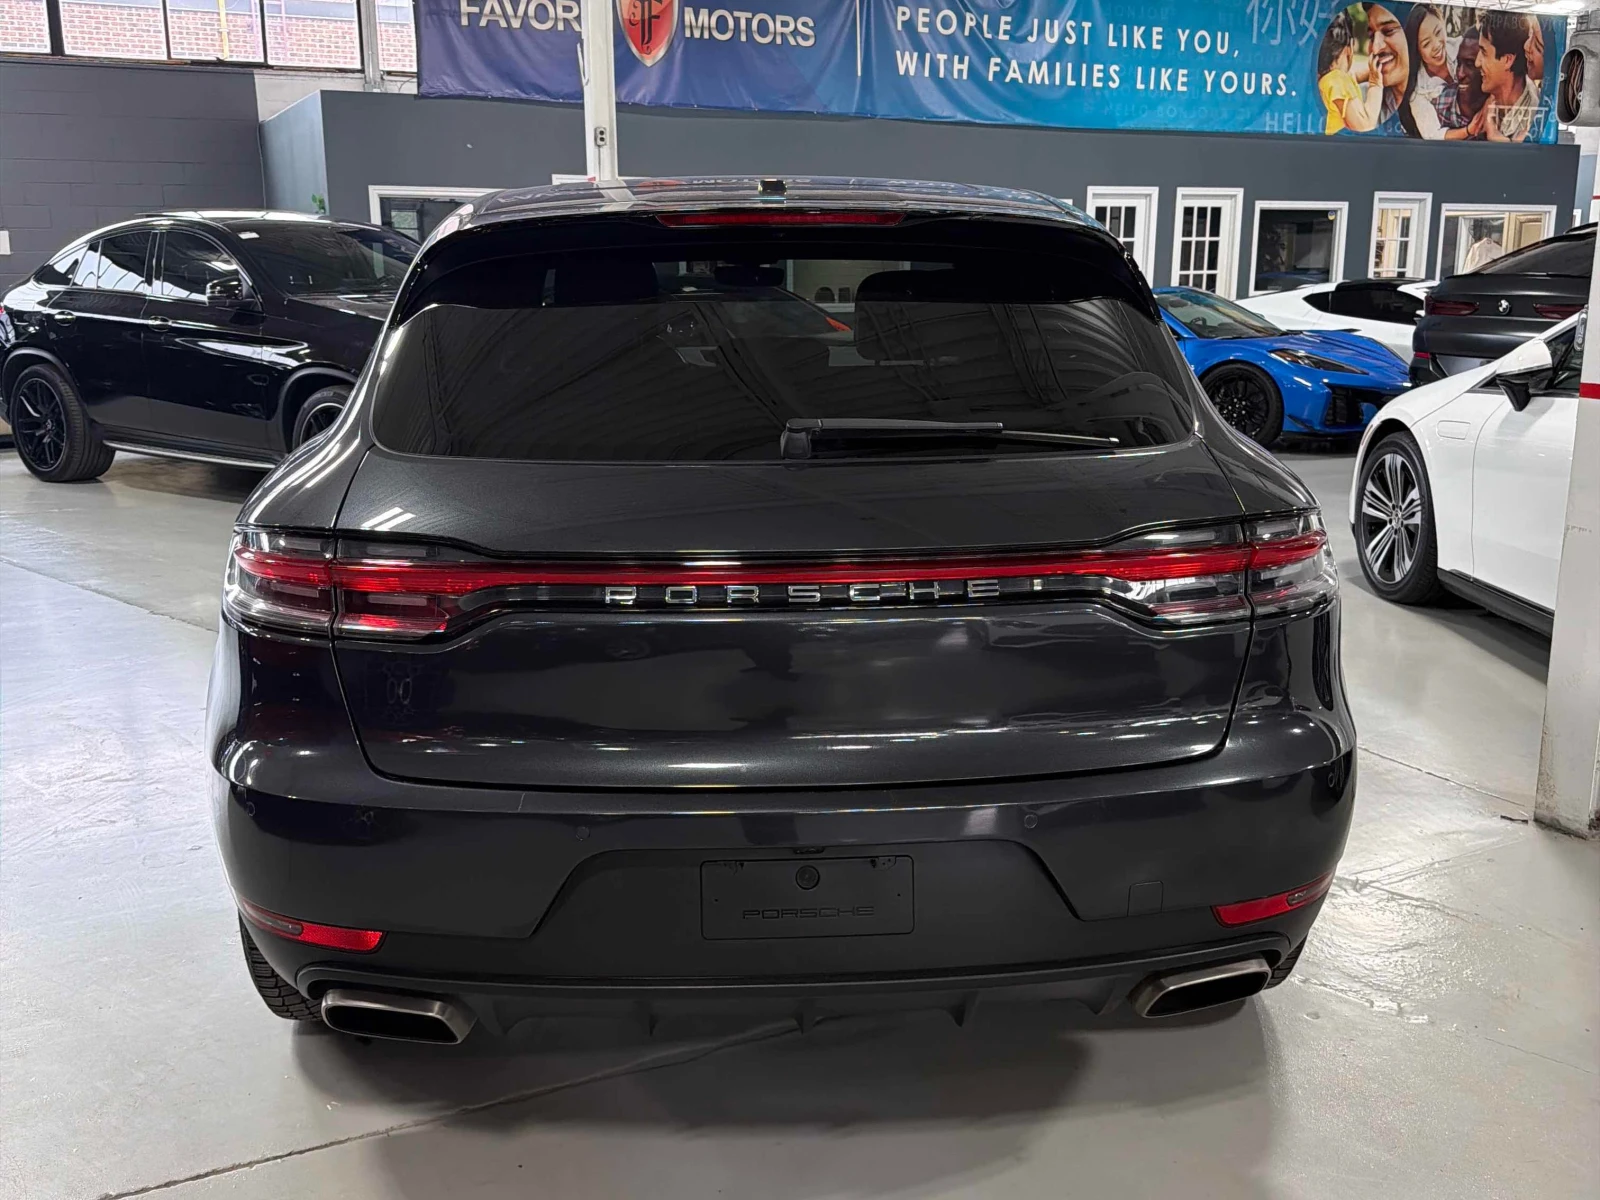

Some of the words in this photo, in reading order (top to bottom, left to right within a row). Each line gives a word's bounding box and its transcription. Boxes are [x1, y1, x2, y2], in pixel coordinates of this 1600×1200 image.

[684, 7, 817, 48] MOTORS
[896, 6, 1012, 41] PEOPLE
[1027, 17, 1093, 46] JUST
[1107, 23, 1164, 51] LIKE
[1177, 28, 1240, 59] YOU,
[896, 50, 969, 81] WITH
[988, 57, 1121, 89] FAMILIES
[1136, 66, 1189, 93] LIKE
[1204, 70, 1298, 97] YOURS.
[604, 579, 1000, 604] PORSCHE
[742, 906, 875, 920] PORSCHE
